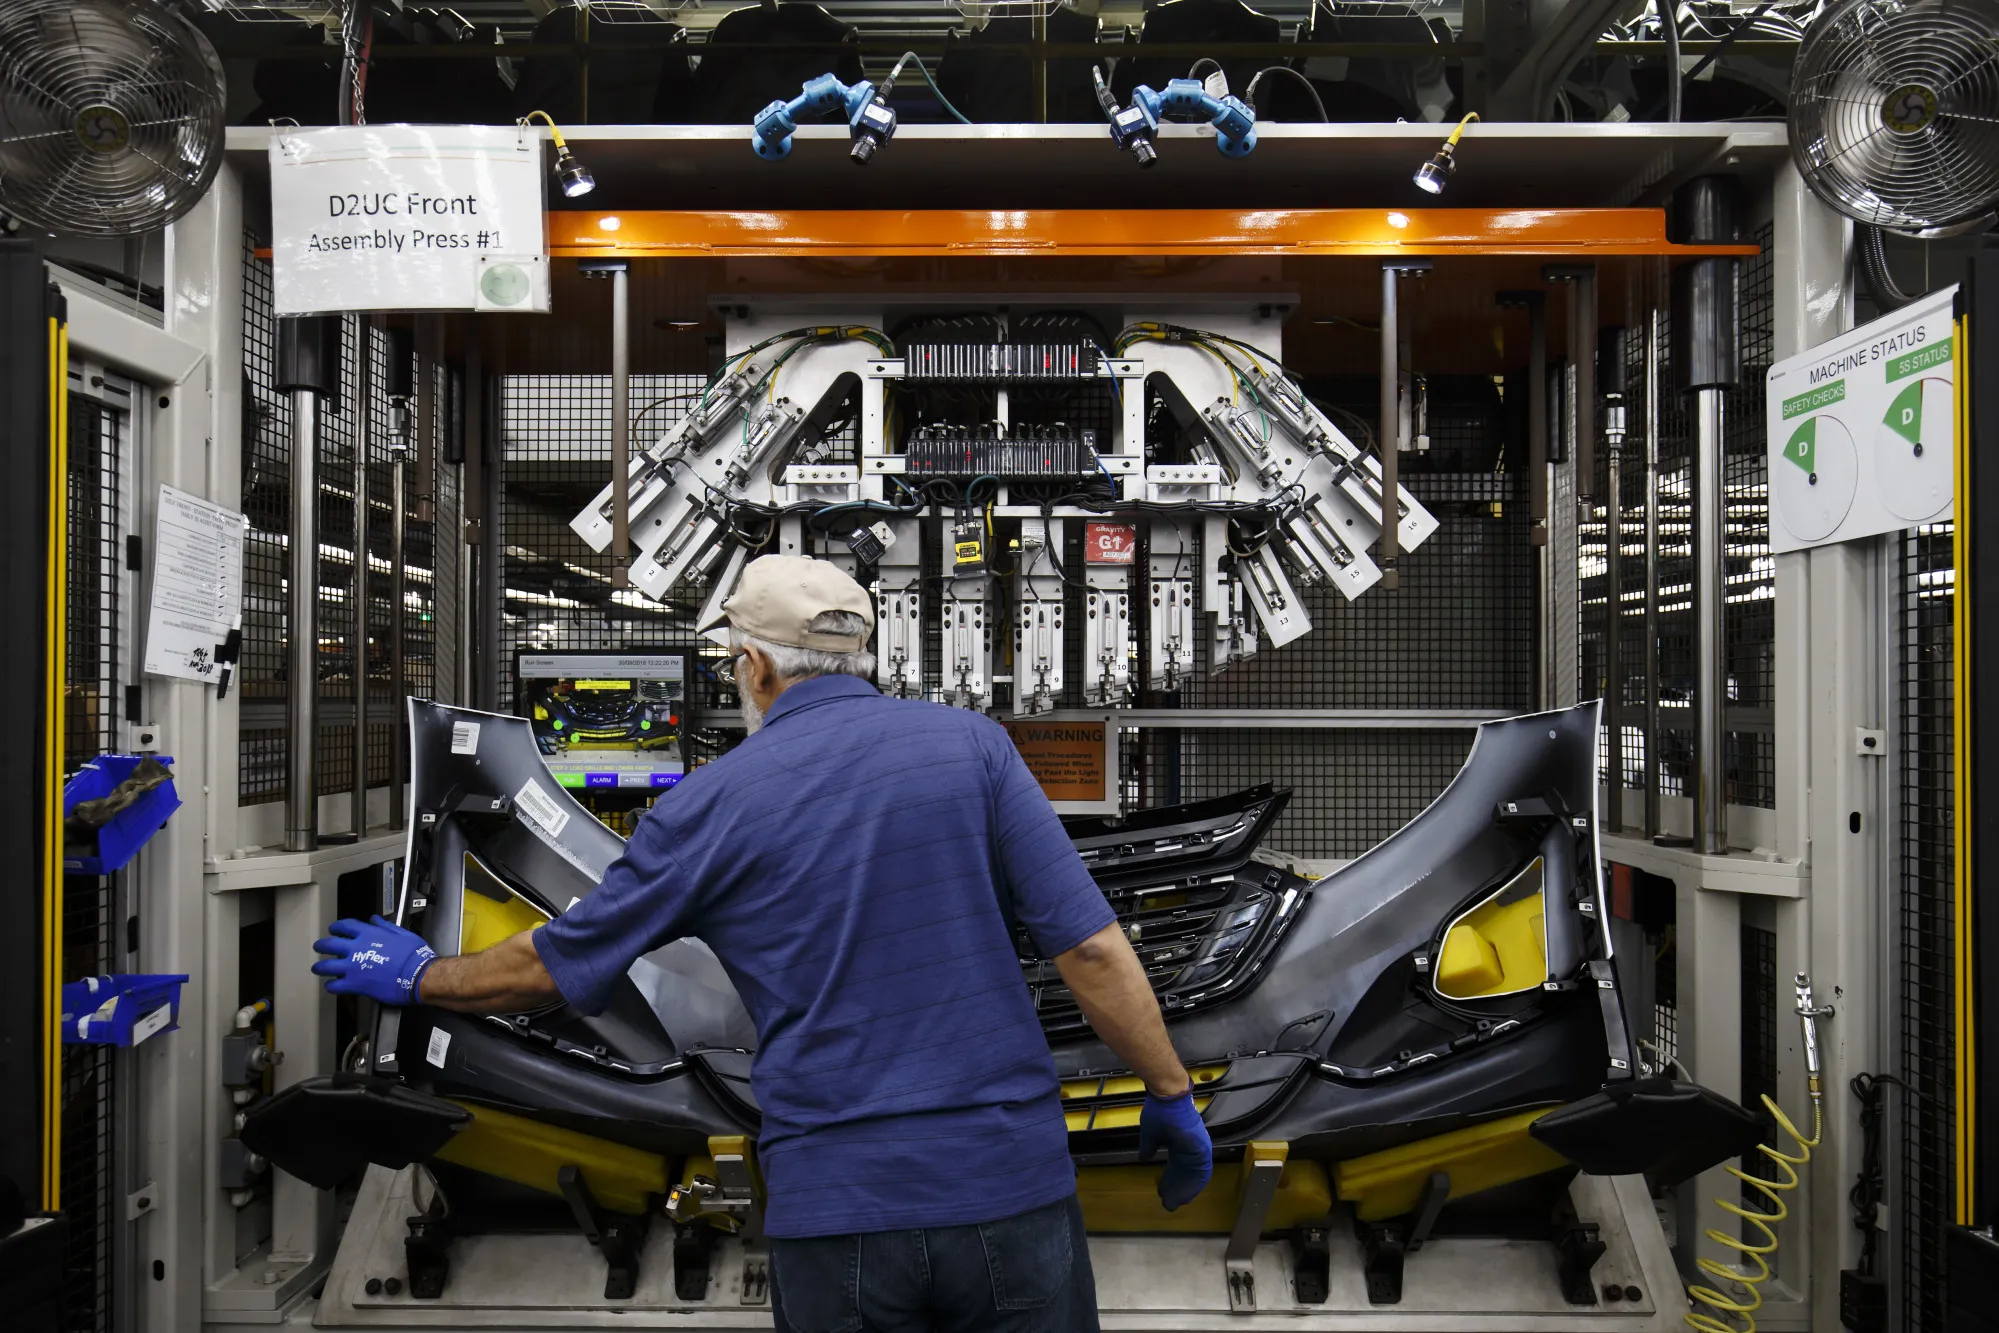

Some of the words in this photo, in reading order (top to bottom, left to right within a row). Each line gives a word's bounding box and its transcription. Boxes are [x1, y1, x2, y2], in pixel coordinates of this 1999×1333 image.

[330, 193, 398, 217] D2UC
[407, 192, 477, 215] Front
[308, 229, 404, 252] Assembly
[412, 230, 470, 249] Press
[476, 230, 504, 249] #1
[1810, 348, 1867, 385] MACHINE
[1870, 325, 1926, 361] STATUS
[1899, 359, 1911, 375] 5S
[1912, 344, 1949, 369] STATUS
[1783, 396, 1812, 416] SAFETY
[1812, 384, 1845, 406] CHECKS
[1902, 408, 1914, 425] D
[1798, 442, 1808, 456] D
[1408, 521, 1418, 531] 16
[1098, 534, 1120, 550] G1
[1350, 570, 1360, 579] 15
[1279, 617, 1289, 626] 13
[1026, 729, 1104, 742] WARNING
[352, 950, 387, 965] HyFlex
